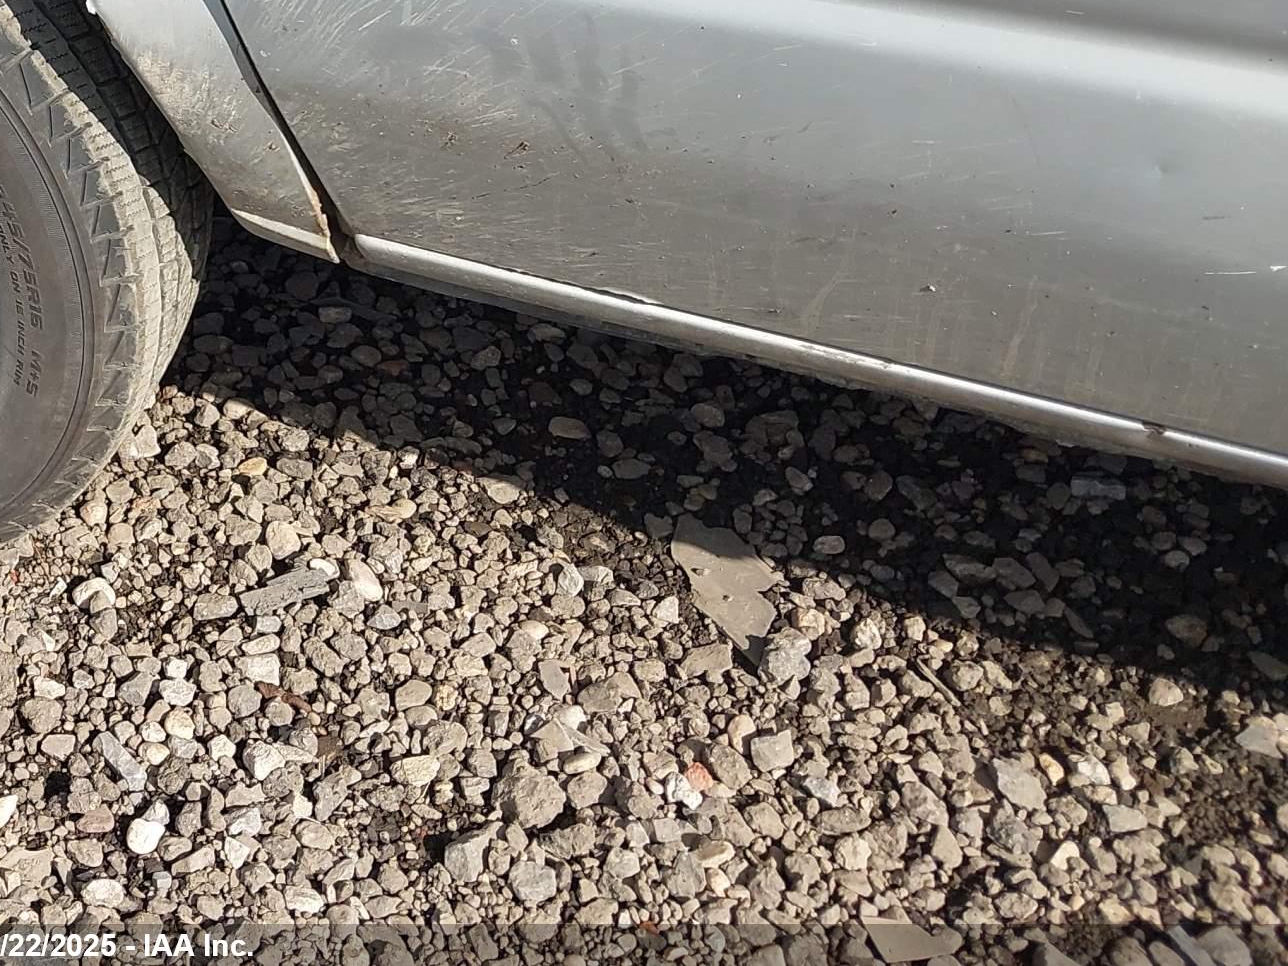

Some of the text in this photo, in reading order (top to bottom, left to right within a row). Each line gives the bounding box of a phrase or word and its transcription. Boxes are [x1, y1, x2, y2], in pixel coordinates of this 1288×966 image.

[10, 271, 21, 294] ON
[17, 320, 25, 356] INCH
[13, 359, 24, 386] RIM
[26, 349, 44, 399] M+S
